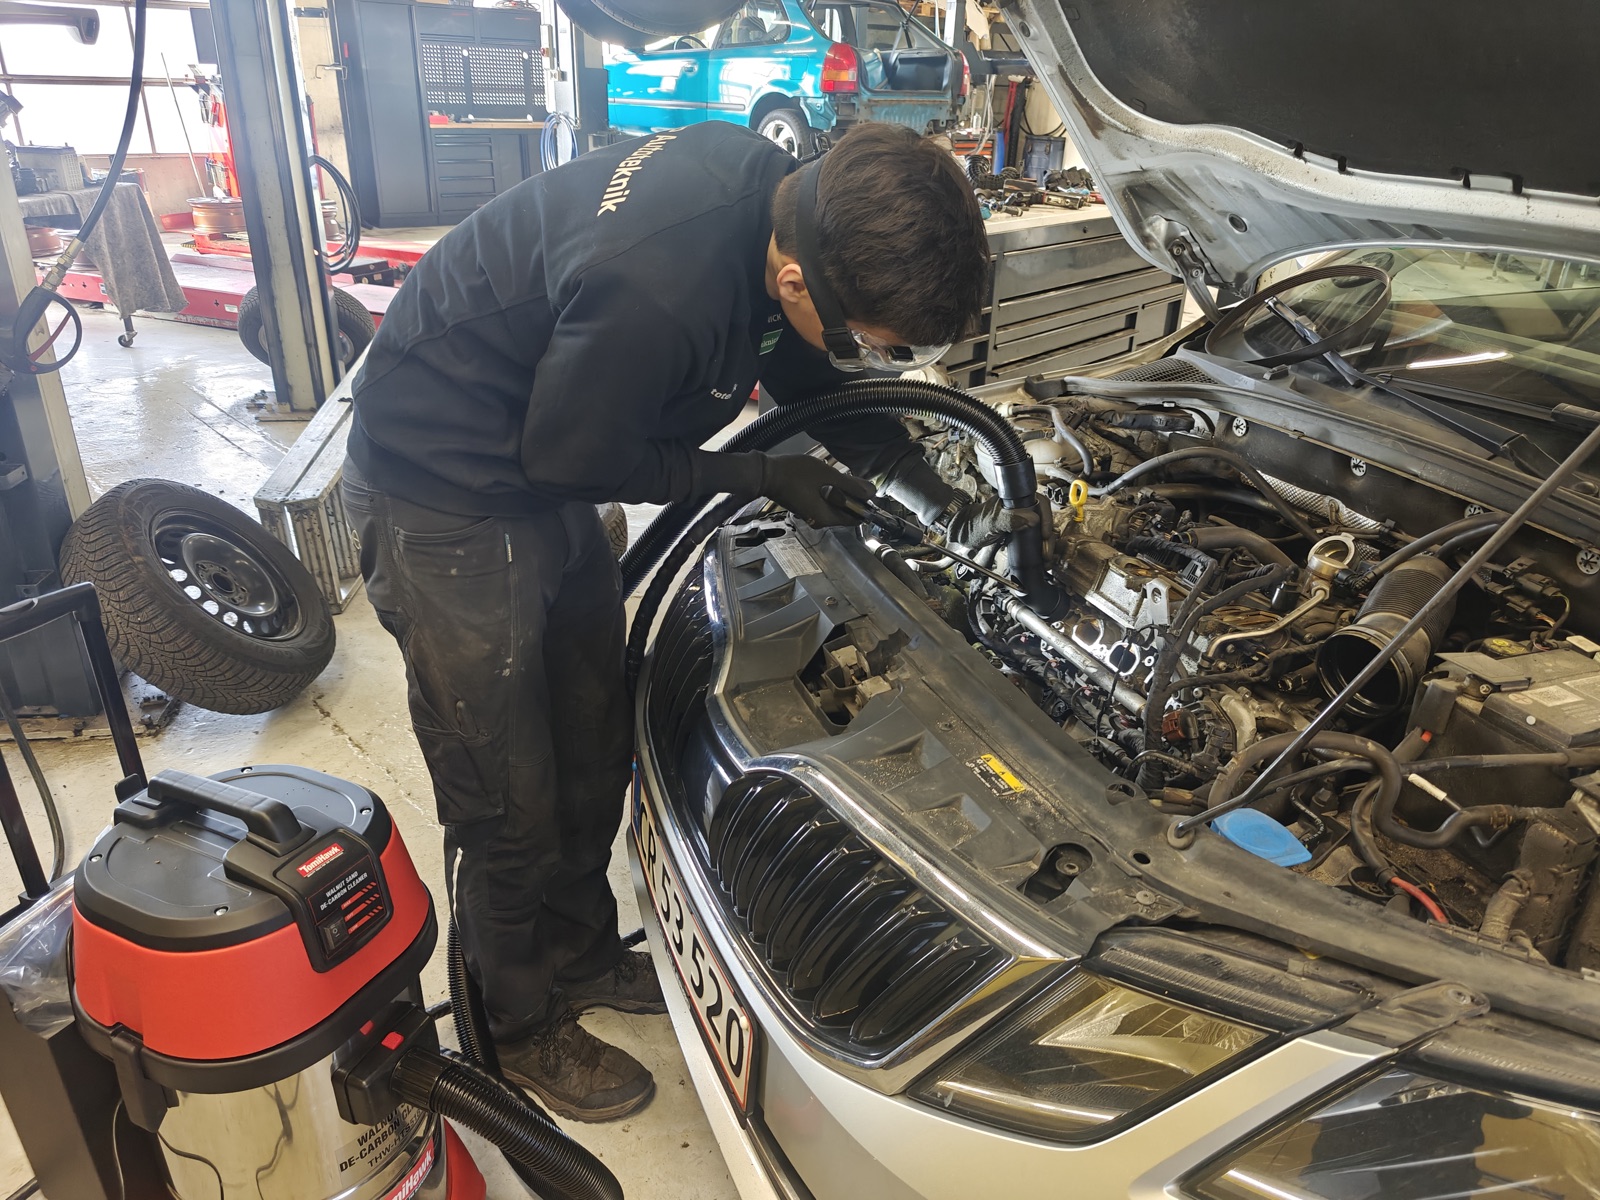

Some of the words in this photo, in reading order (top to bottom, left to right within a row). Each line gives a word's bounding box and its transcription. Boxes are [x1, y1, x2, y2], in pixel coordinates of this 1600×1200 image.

[597, 135, 677, 217] Autoteknik
[298, 845, 341, 874] TomiHawk
[319, 887, 348, 911] DE-CARBON
[346, 872, 368, 891] CLEANER
[325, 880, 346, 898] WALNUT
[345, 870, 359, 884] SAND
[640, 801, 657, 892] CR
[660, 861, 684, 956] 53
[690, 932, 744, 1078] 520
[339, 1118, 401, 1173] DE-CARBON
